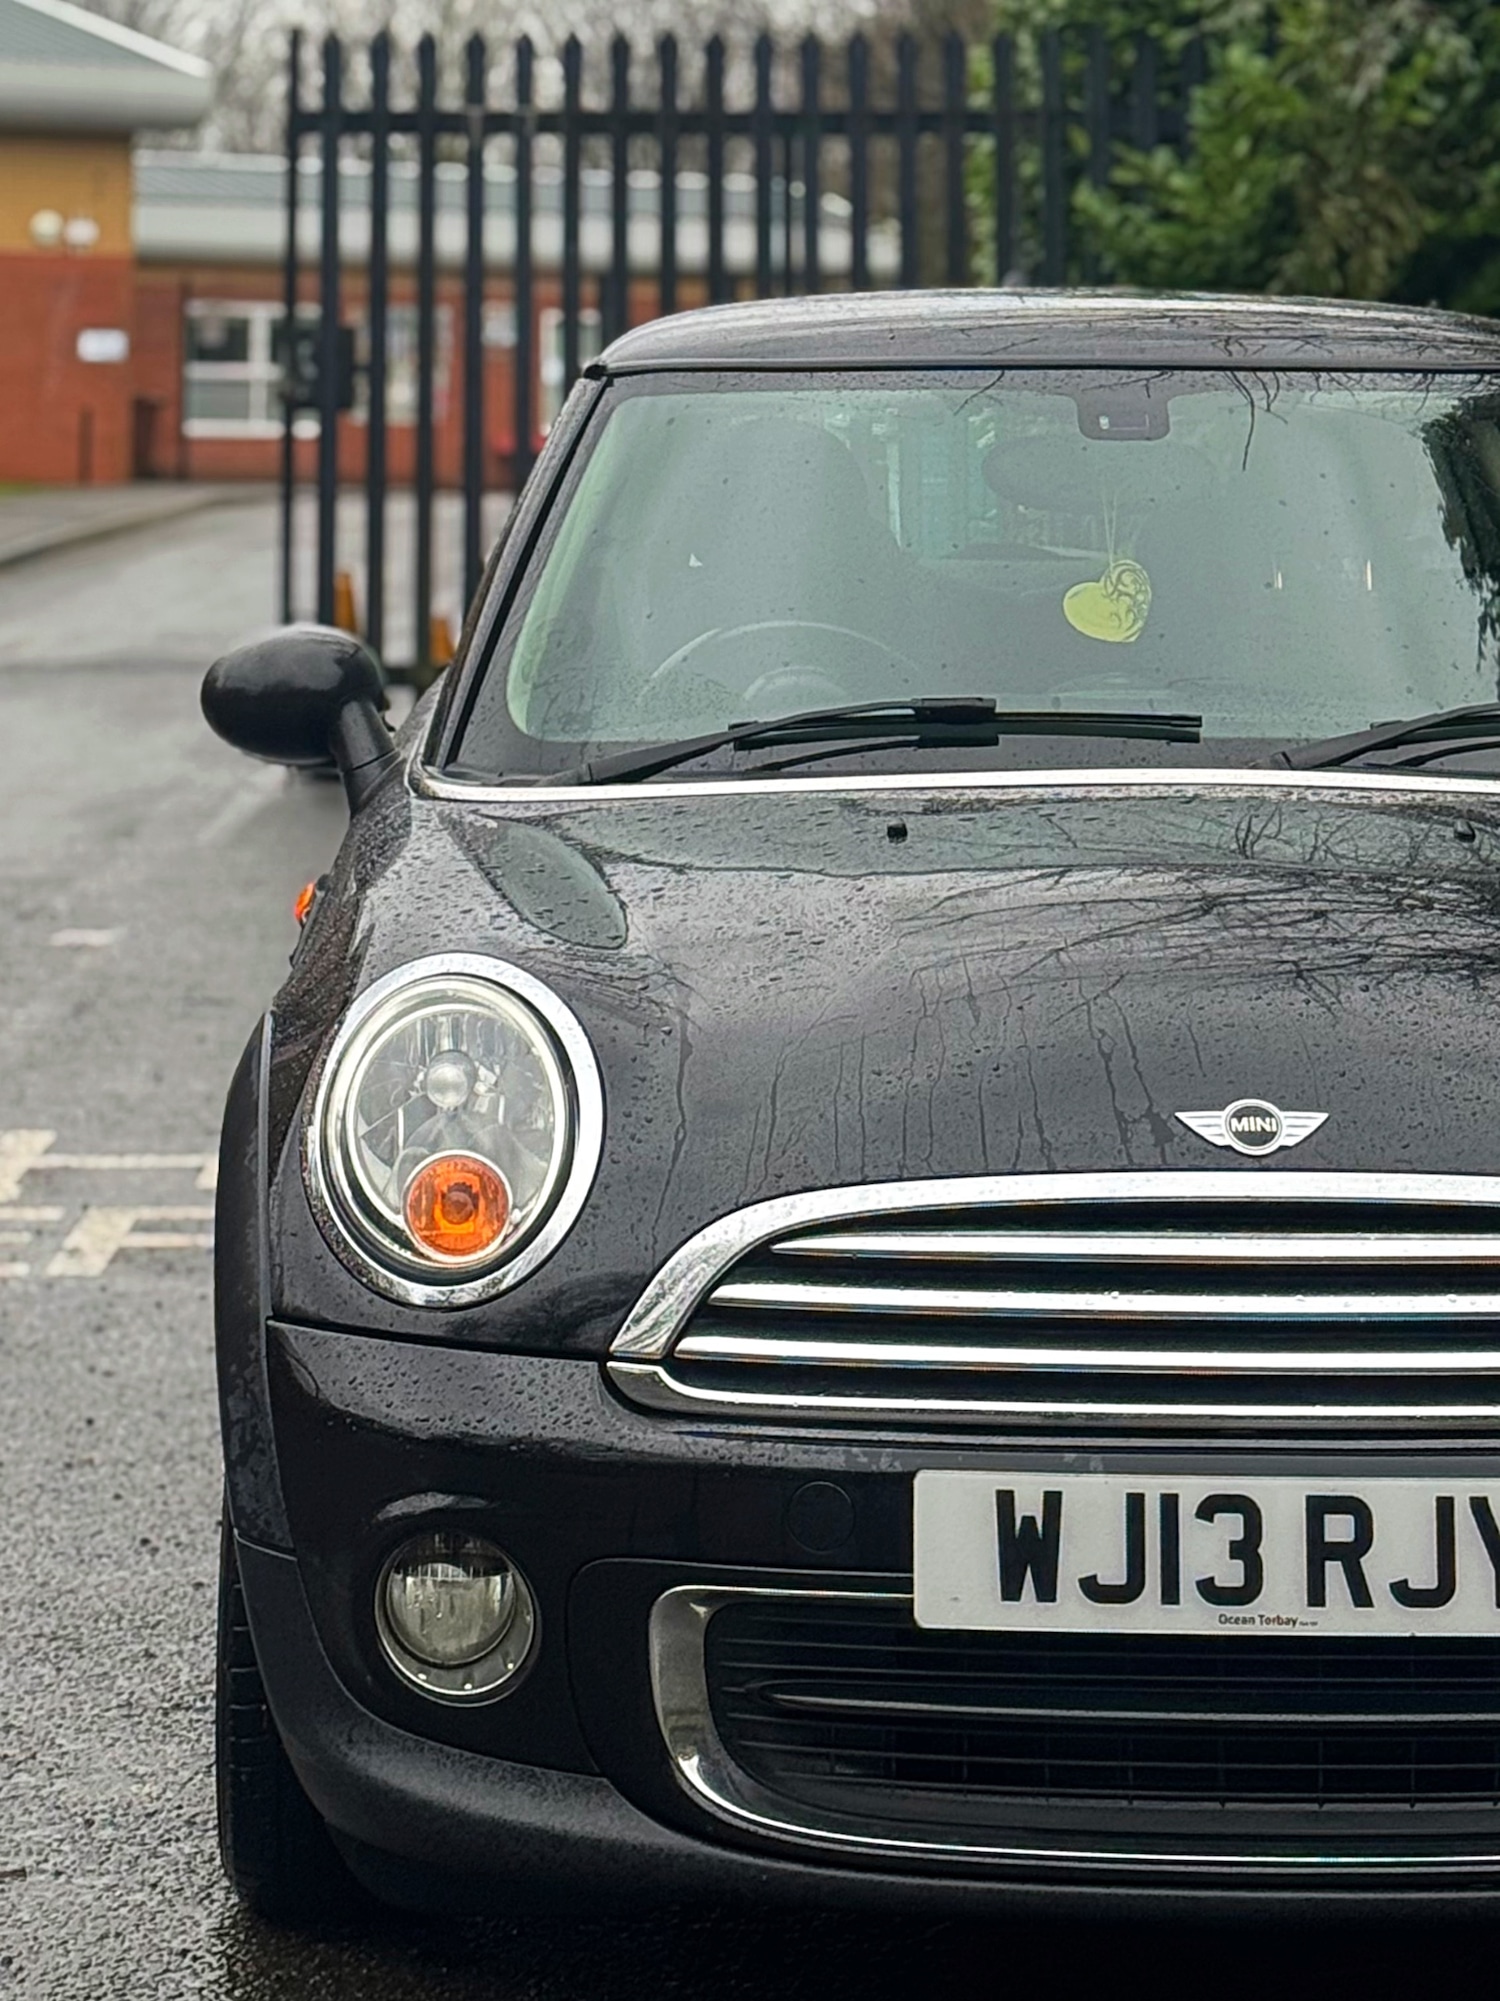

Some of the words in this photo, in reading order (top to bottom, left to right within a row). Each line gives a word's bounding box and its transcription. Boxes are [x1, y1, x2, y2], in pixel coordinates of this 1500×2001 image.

[1231, 1116, 1278, 1133] MINI
[994, 1488, 1264, 1607] WJ13
[1218, 1613, 1256, 1626] Ocean
[1257, 1614, 1299, 1628] Torbay
